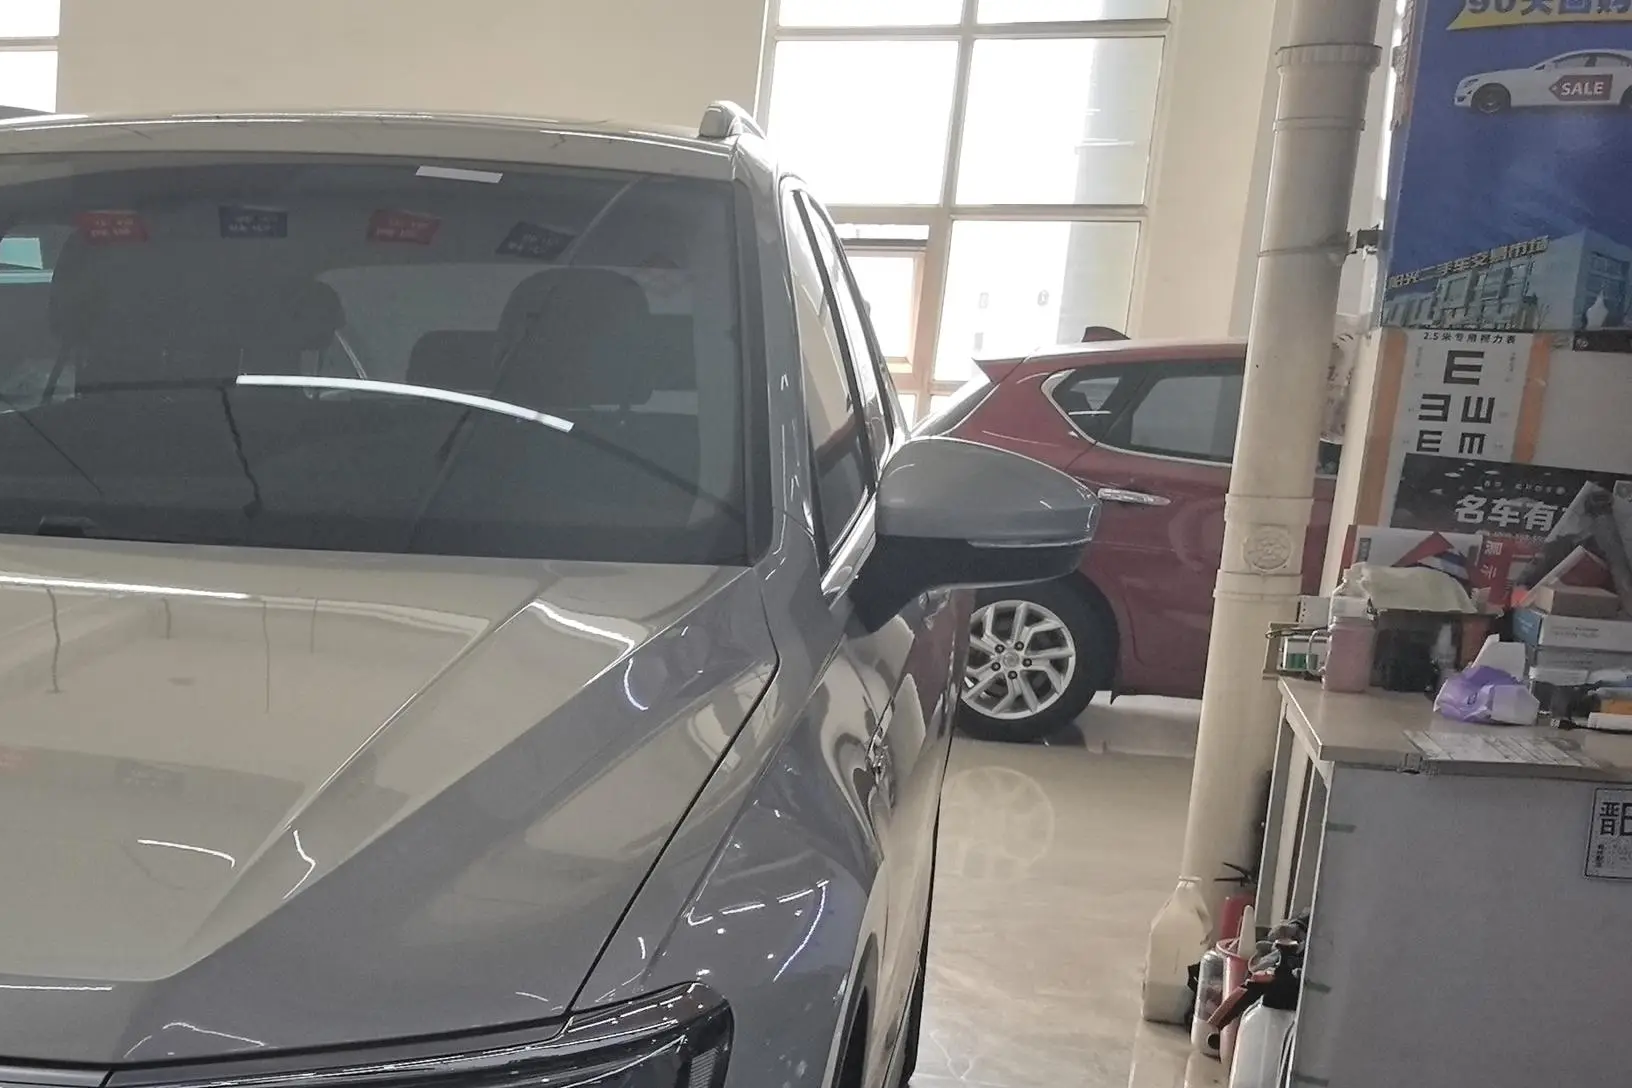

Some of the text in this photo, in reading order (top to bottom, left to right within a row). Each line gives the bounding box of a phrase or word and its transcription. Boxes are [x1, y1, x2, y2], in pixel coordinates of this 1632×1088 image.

[1560, 81, 1605, 96] SALE
[1455, 494, 1567, 532] 名车有
